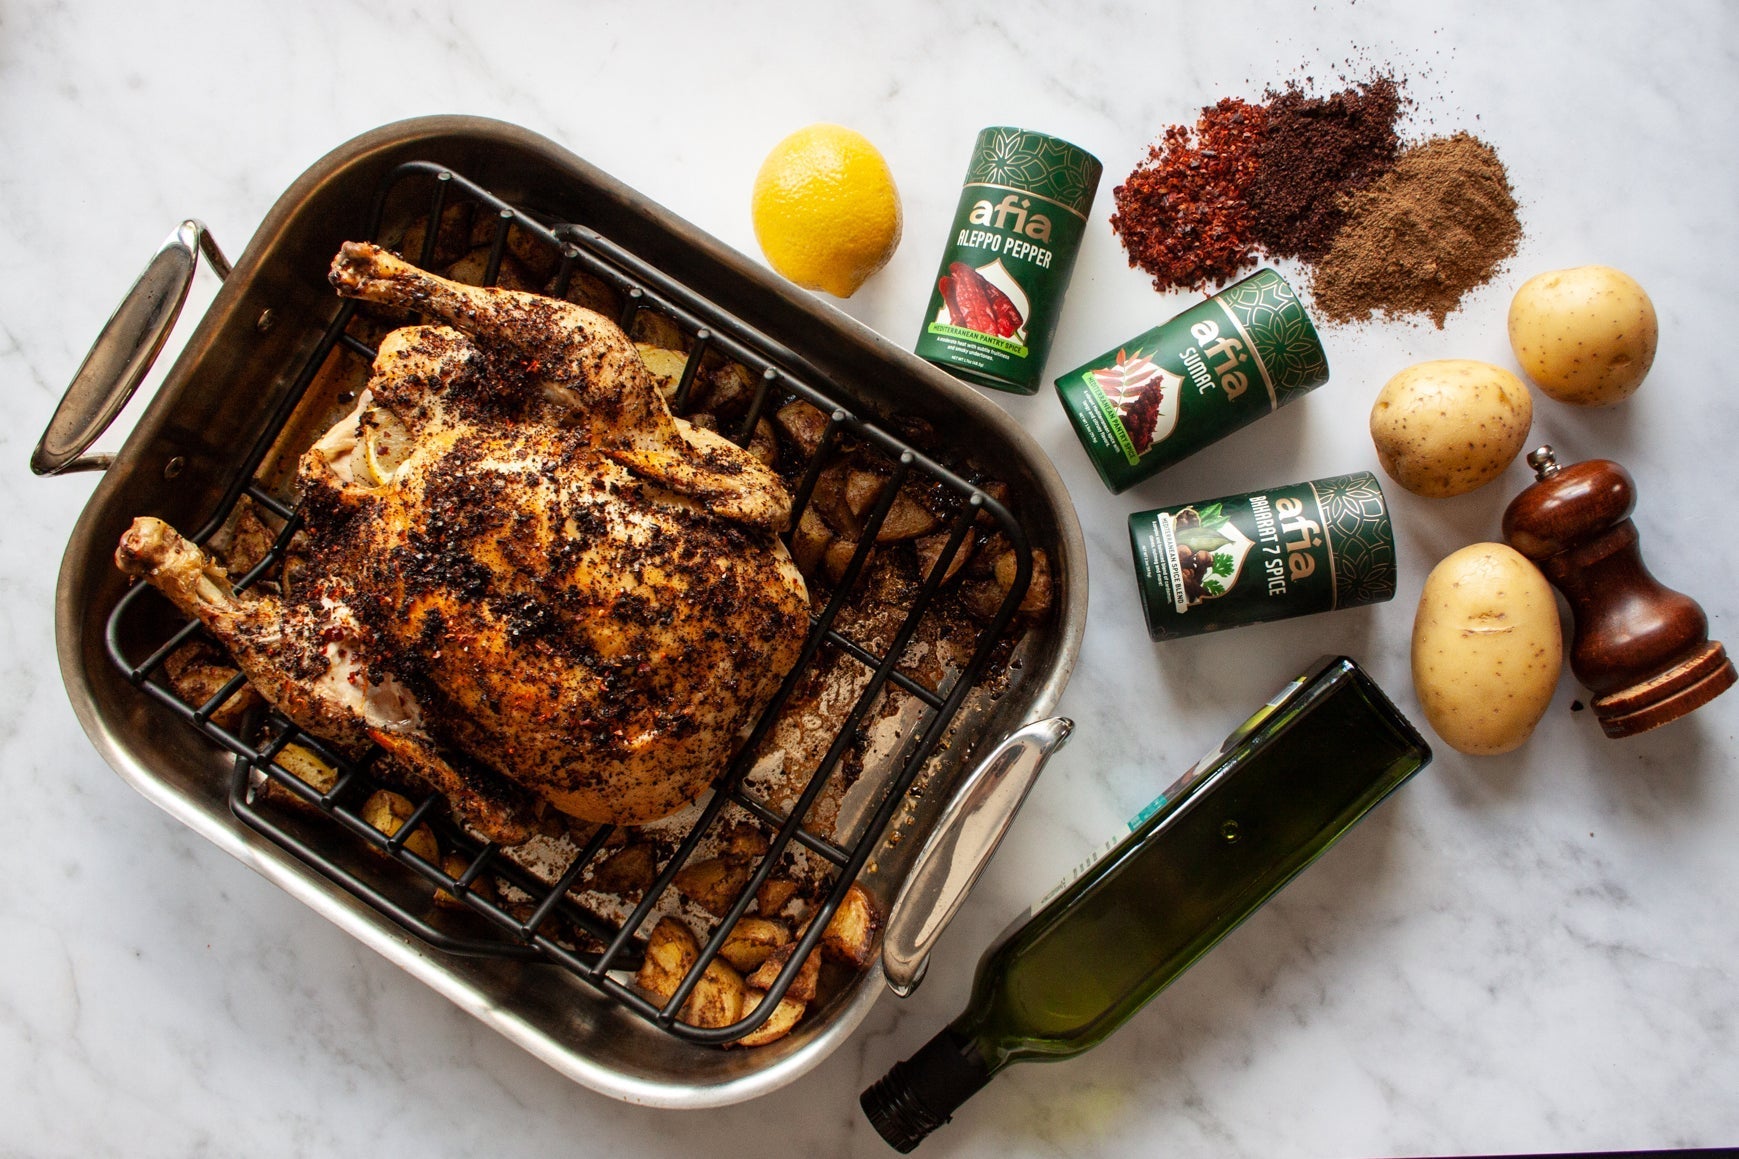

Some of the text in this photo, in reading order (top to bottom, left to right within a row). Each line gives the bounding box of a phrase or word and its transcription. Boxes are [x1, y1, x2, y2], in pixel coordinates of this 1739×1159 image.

[969, 194, 1052, 244] afia
[957, 229, 1053, 269] ALEPPO PEPPER
[933, 324, 1022, 354] MEDITERRANEAN PANTRY SPICE
[990, 350, 1010, 359] fruitiness
[1190, 320, 1249, 402] afia
[1179, 347, 1216, 395] SUMAC
[1088, 377, 1136, 458] MEDITERRANEAN PANTRY SPICE
[1106, 432, 1115, 444] spice
[1112, 443, 1120, 453] with
[1162, 518, 1184, 604] MEDITERRANEAN SPICE BLEND
[1249, 495, 1286, 596] BAHARAT 7 SPICE
[1275, 497, 1322, 582] afia
